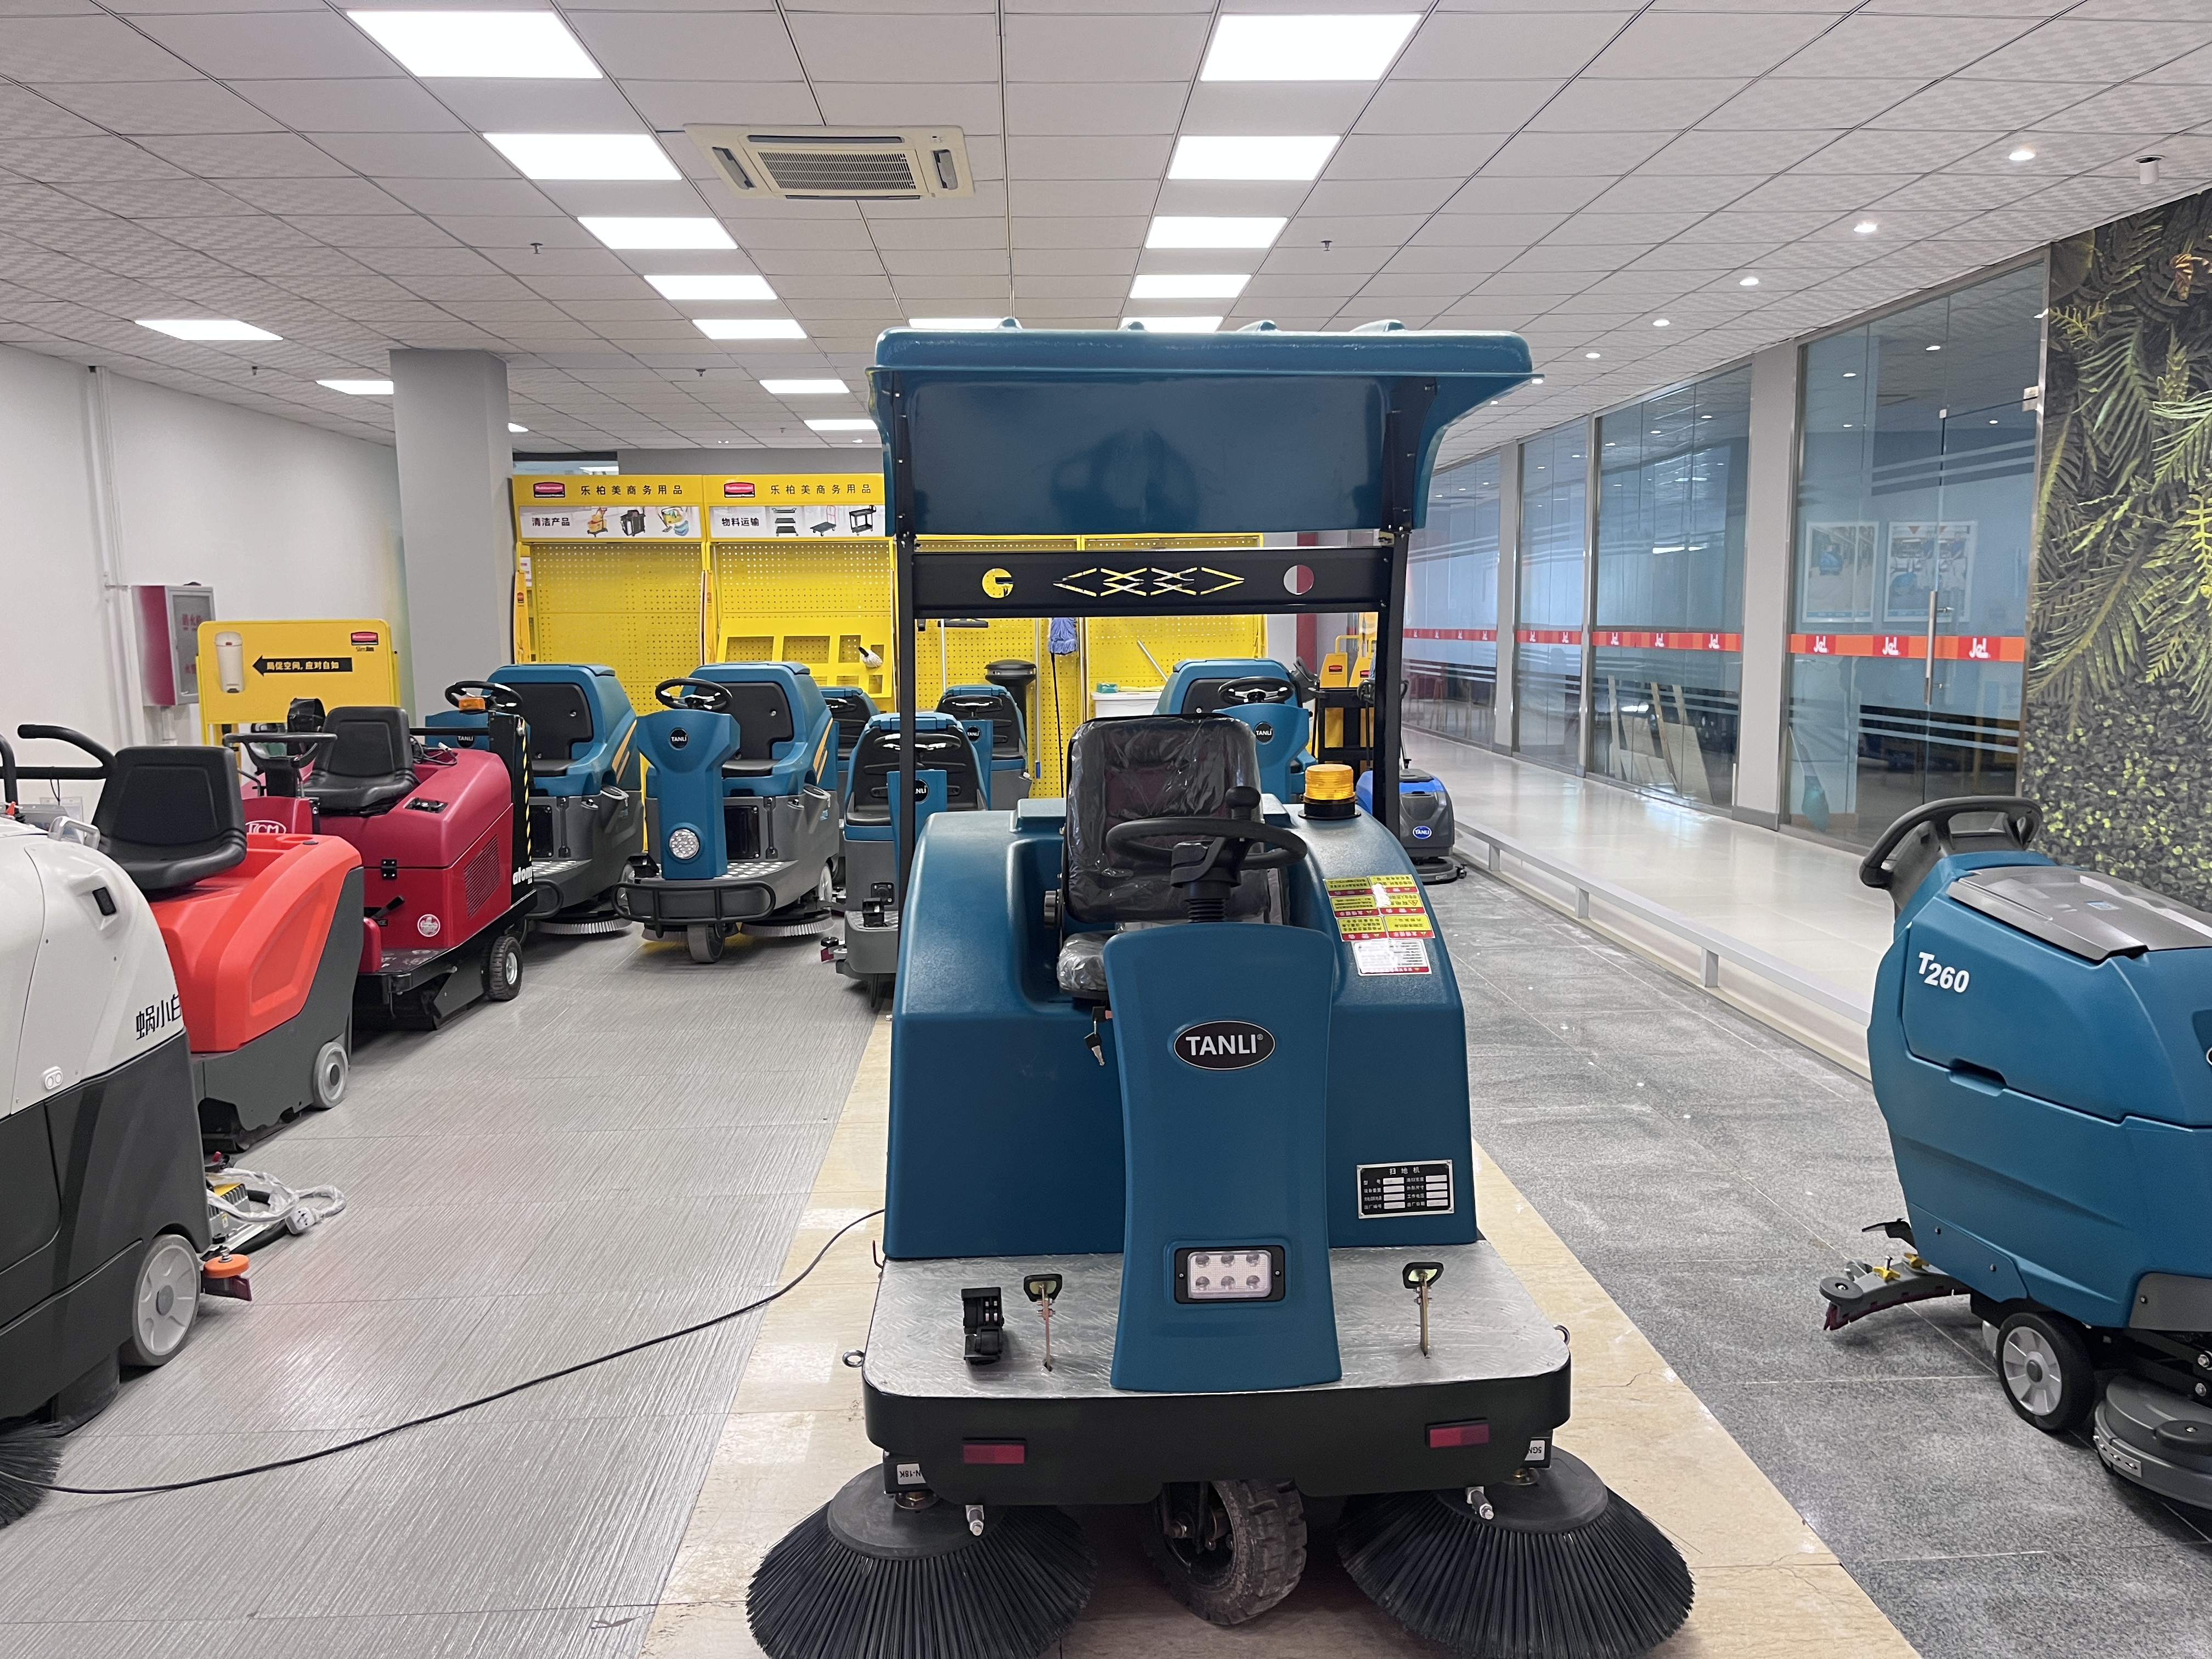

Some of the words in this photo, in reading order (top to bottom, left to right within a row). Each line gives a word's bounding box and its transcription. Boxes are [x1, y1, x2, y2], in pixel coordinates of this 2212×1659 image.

[580, 485, 682, 495] 乐柏美商务用品
[770, 484, 871, 495] 乐柏美商务用品
[532, 517, 570, 527] 清洁产品
[721, 517, 759, 527] 物料运输
[1918, 951, 1970, 993] T260
[136, 994, 182, 1041] 蜗小白
[1185, 1034, 1258, 1056] TANLI
[1389, 1166, 1420, 1175] 扫地机
